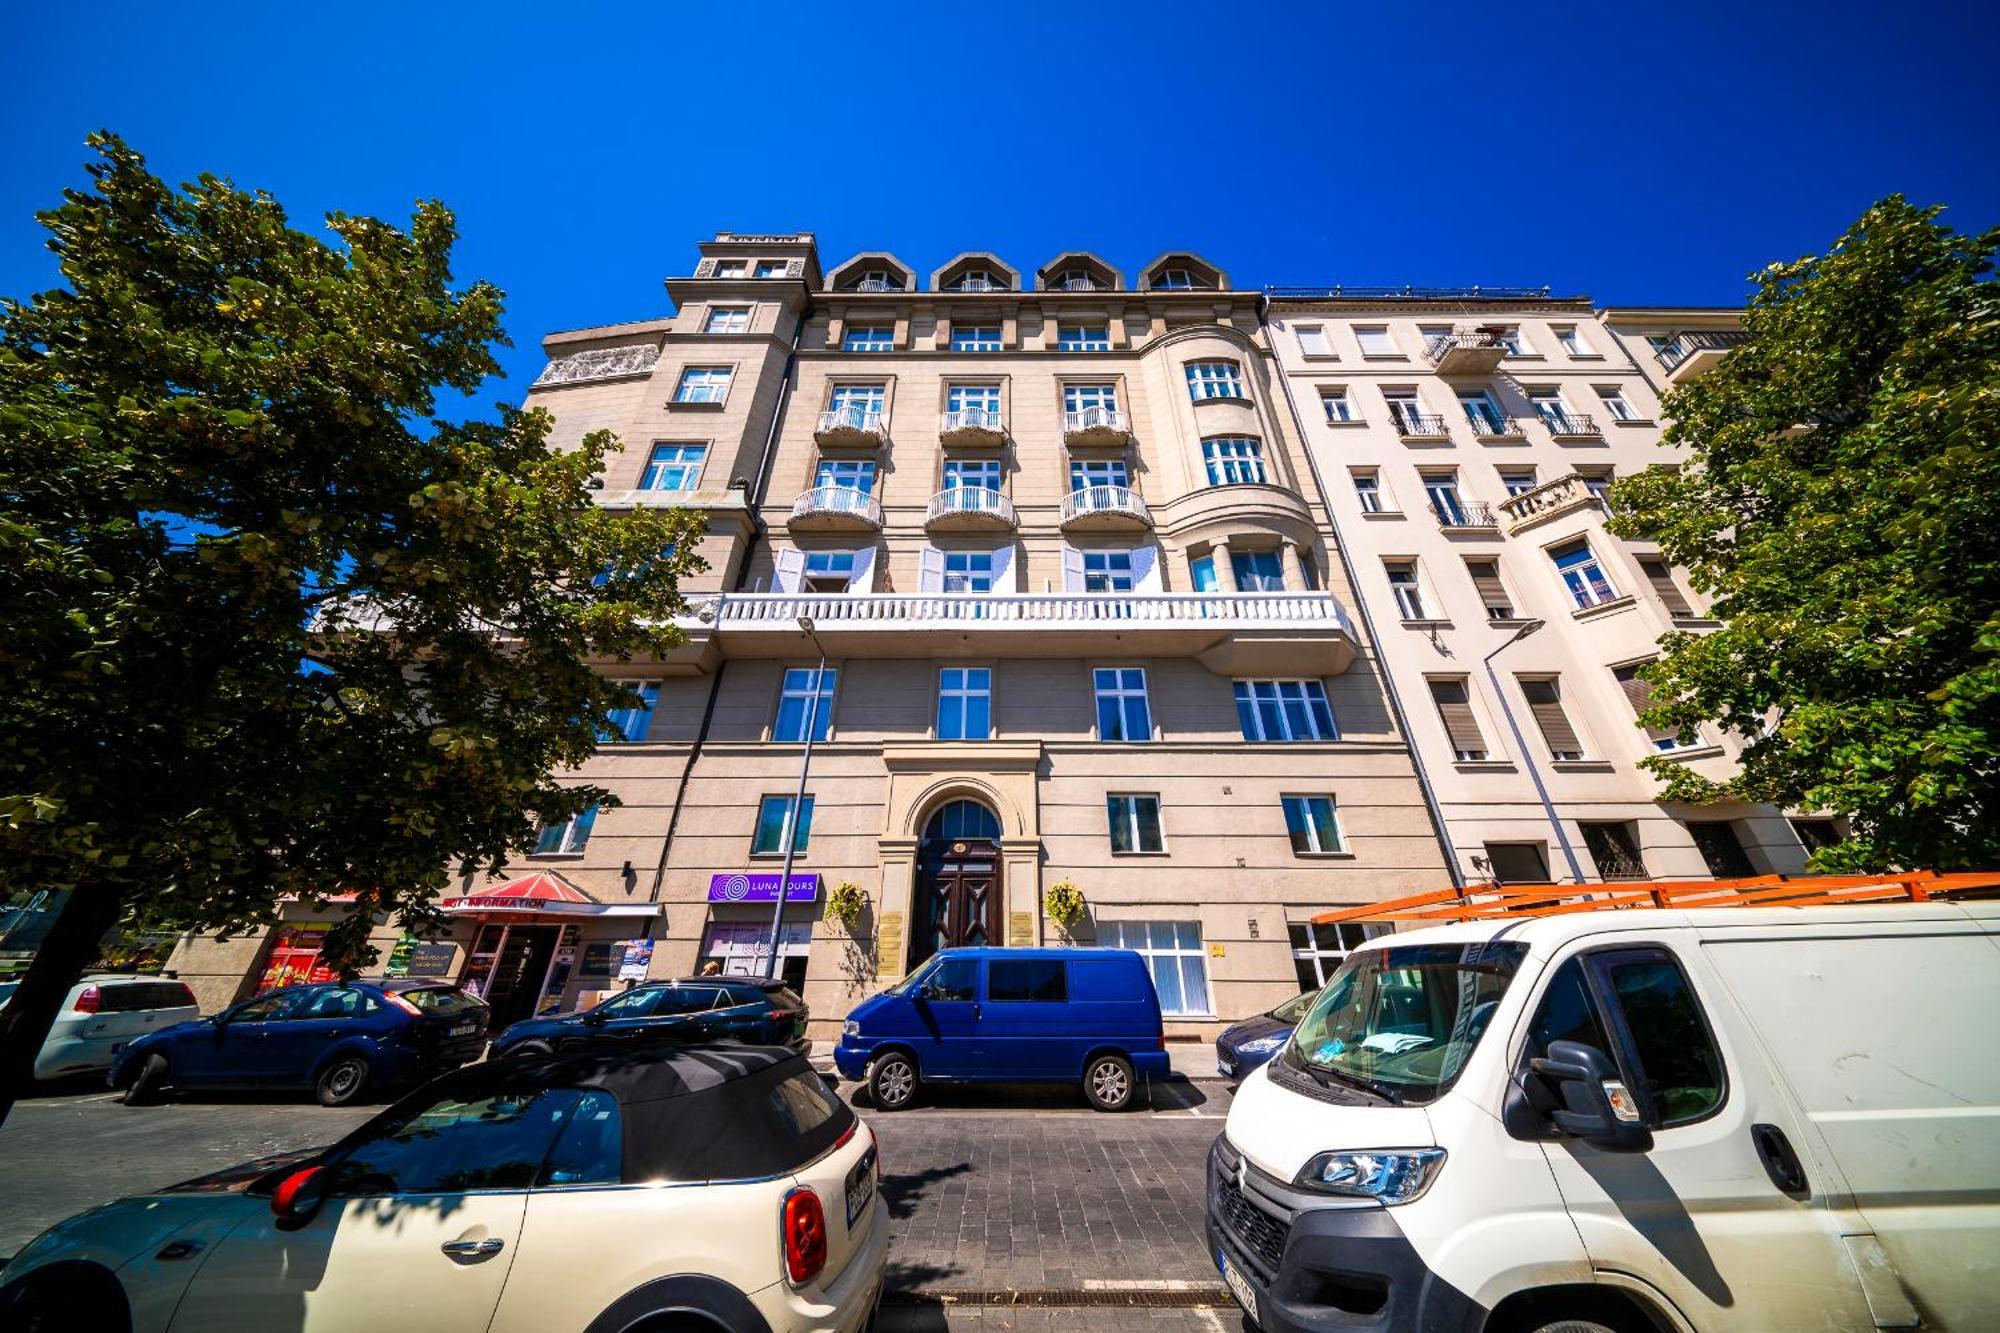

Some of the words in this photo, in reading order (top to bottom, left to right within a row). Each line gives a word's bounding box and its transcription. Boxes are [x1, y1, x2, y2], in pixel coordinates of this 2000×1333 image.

[751, 882, 778, 890] LUNA
[783, 882, 813, 890] OURS
[467, 899, 546, 909] INFORMATION
